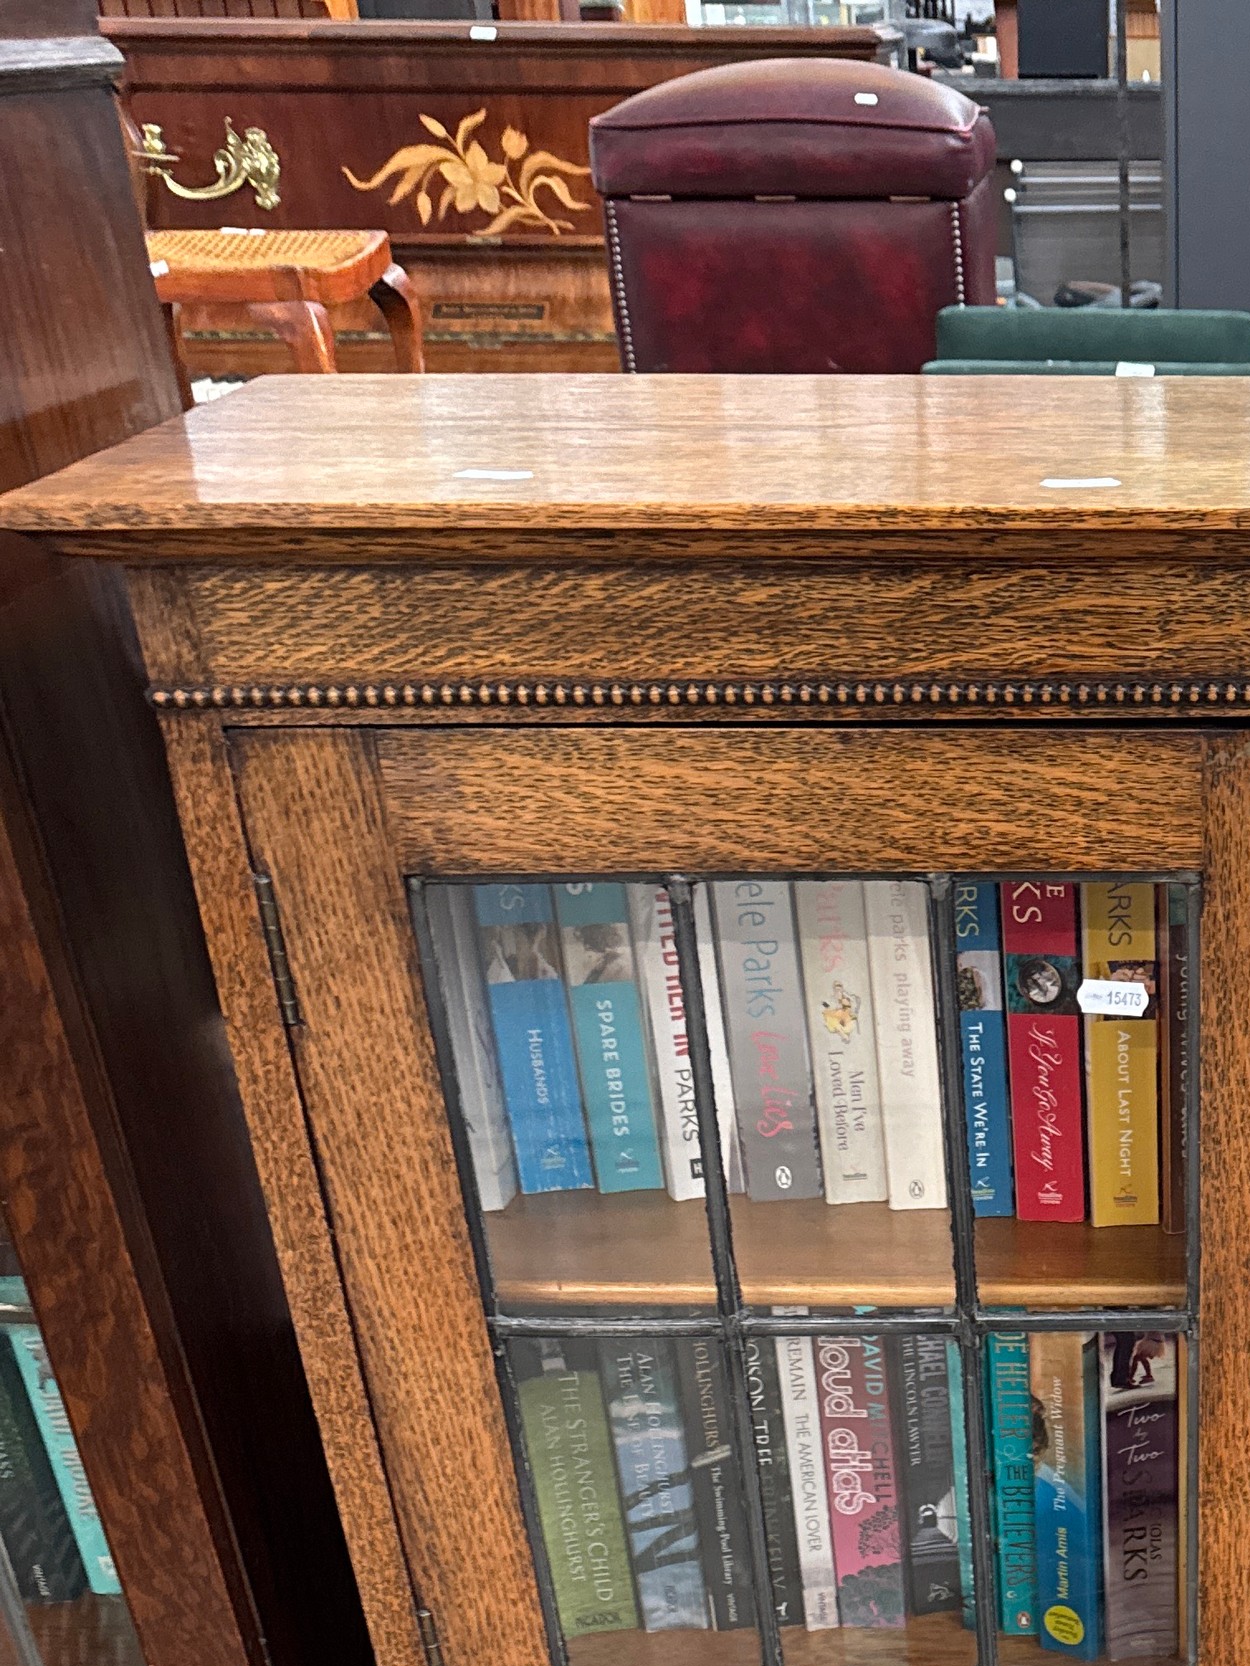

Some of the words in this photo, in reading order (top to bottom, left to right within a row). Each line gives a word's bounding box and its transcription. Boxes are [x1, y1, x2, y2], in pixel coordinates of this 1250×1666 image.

[889, 913, 908, 962] parks
[741, 938, 784, 1018] Parks
[893, 971, 913, 1032] playing
[1107, 990, 1143, 1007] 15473
[596, 999, 620, 1062] SPARE
[967, 1022, 984, 1044] THE
[900, 1039, 915, 1079] away
[969, 1045, 985, 1097] STATE
[1028, 1043, 1063, 1087] You
[1116, 1030, 1132, 1083] ABOUT
[605, 1065, 631, 1137] BRIDES
[674, 1068, 700, 1142] PARKS
[1117, 1087, 1131, 1127] LAST
[976, 1151, 988, 1168] IN
[1118, 1129, 1132, 1179] NIGHT
[558, 1371, 582, 1415] THE
[904, 1362, 919, 1416] LINCOLN
[996, 1362, 1030, 1440] HELLER
[1051, 1376, 1063, 1421] Widow
[795, 1414, 811, 1438] THE
[1117, 1402, 1166, 1428] Two
[755, 1419, 773, 1466] TREE
[867, 1402, 894, 1504] MITCHELL
[908, 1418, 921, 1467] LAWYER
[1053, 1424, 1065, 1484] Pregnant
[1117, 1440, 1165, 1466] Two
[539, 1403, 559, 1451] ALAN
[549, 1454, 588, 1583] HOLLINGHURST
[566, 1417, 604, 1539] STRANGER'S
[799, 1443, 818, 1512] AMERICAN
[828, 1427, 876, 1514] atlas
[1005, 1465, 1029, 1481] THE
[1053, 1488, 1067, 1512] The
[805, 1513, 823, 1552] LOVER
[1001, 1486, 1037, 1588] BELIEVERS
[1056, 1527, 1068, 1556] Amis
[1121, 1470, 1152, 1582] SPARKS
[587, 1541, 615, 1602] CHILD
[1056, 1557, 1069, 1600] Martin
